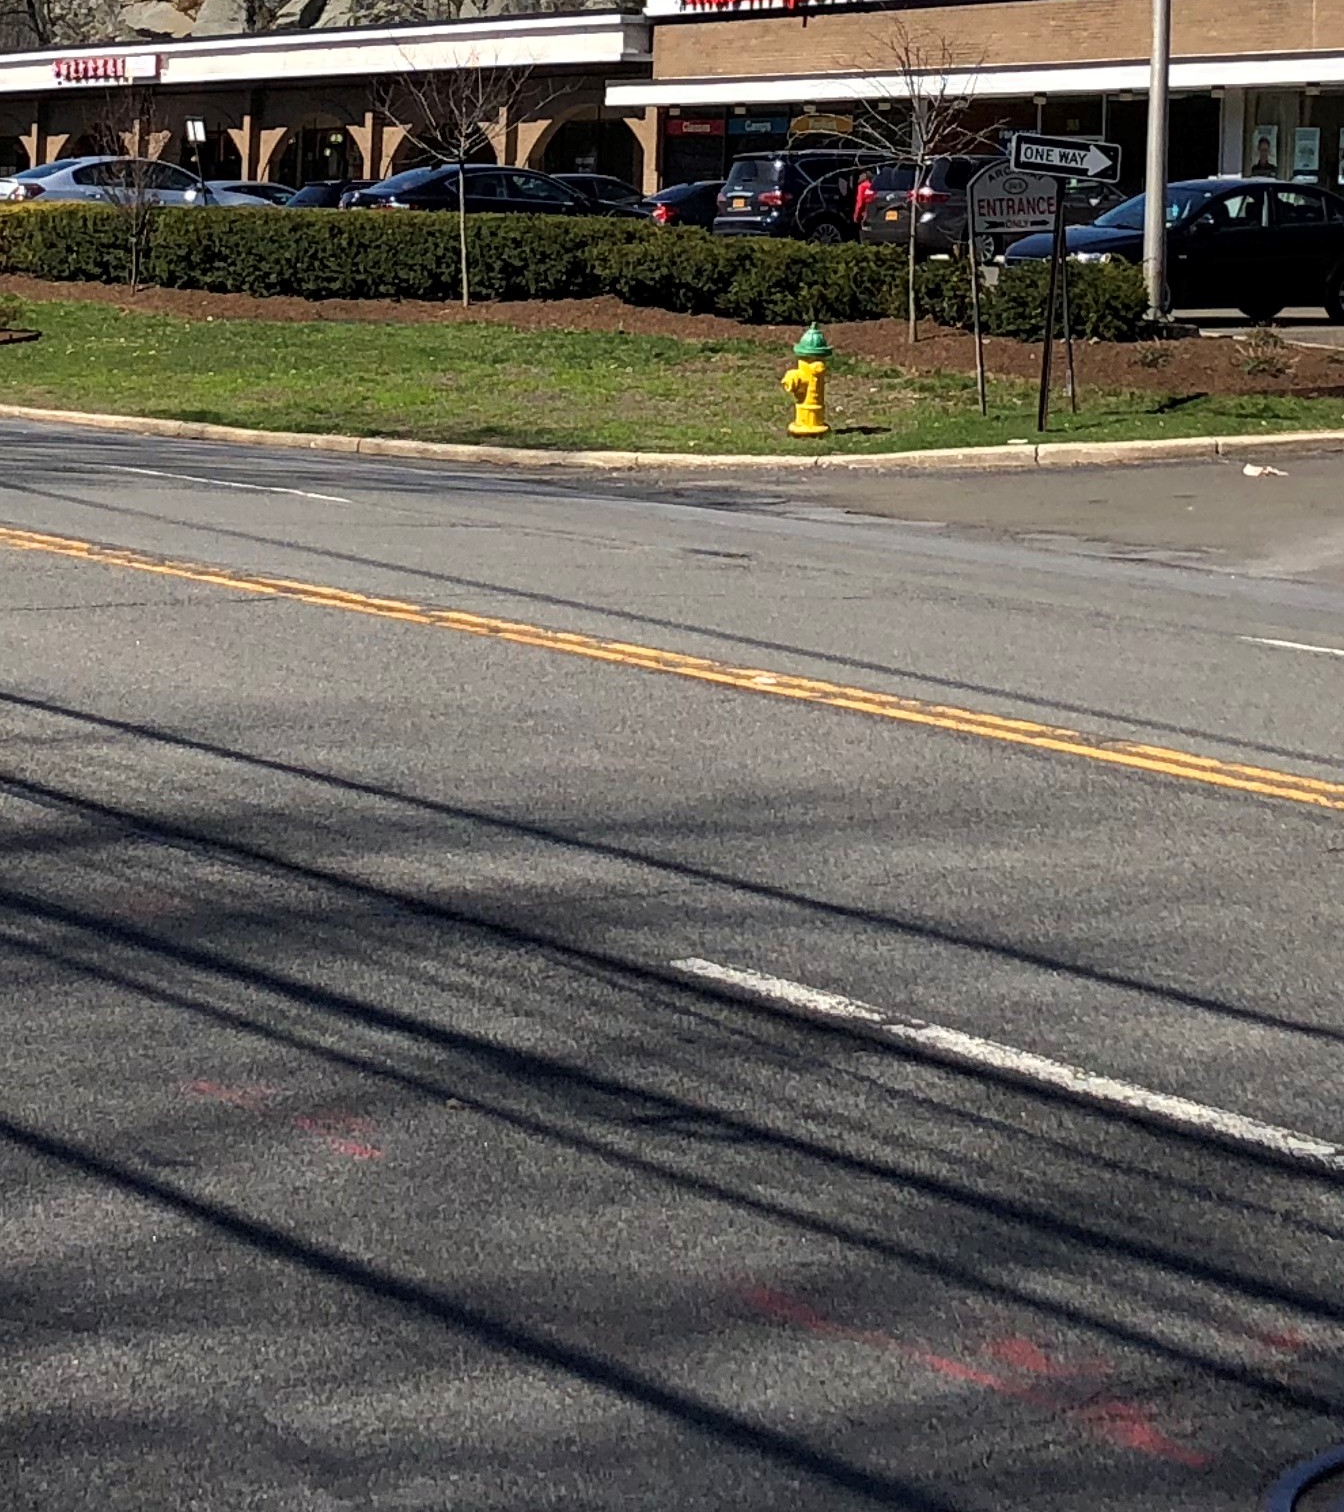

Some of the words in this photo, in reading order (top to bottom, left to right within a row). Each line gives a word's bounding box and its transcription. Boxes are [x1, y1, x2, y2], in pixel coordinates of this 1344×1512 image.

[1023, 146, 1055, 163] ONE
[1058, 149, 1089, 166] WAY
[977, 196, 1056, 217] ENTRANCE
[1006, 219, 1030, 229] ONLY
